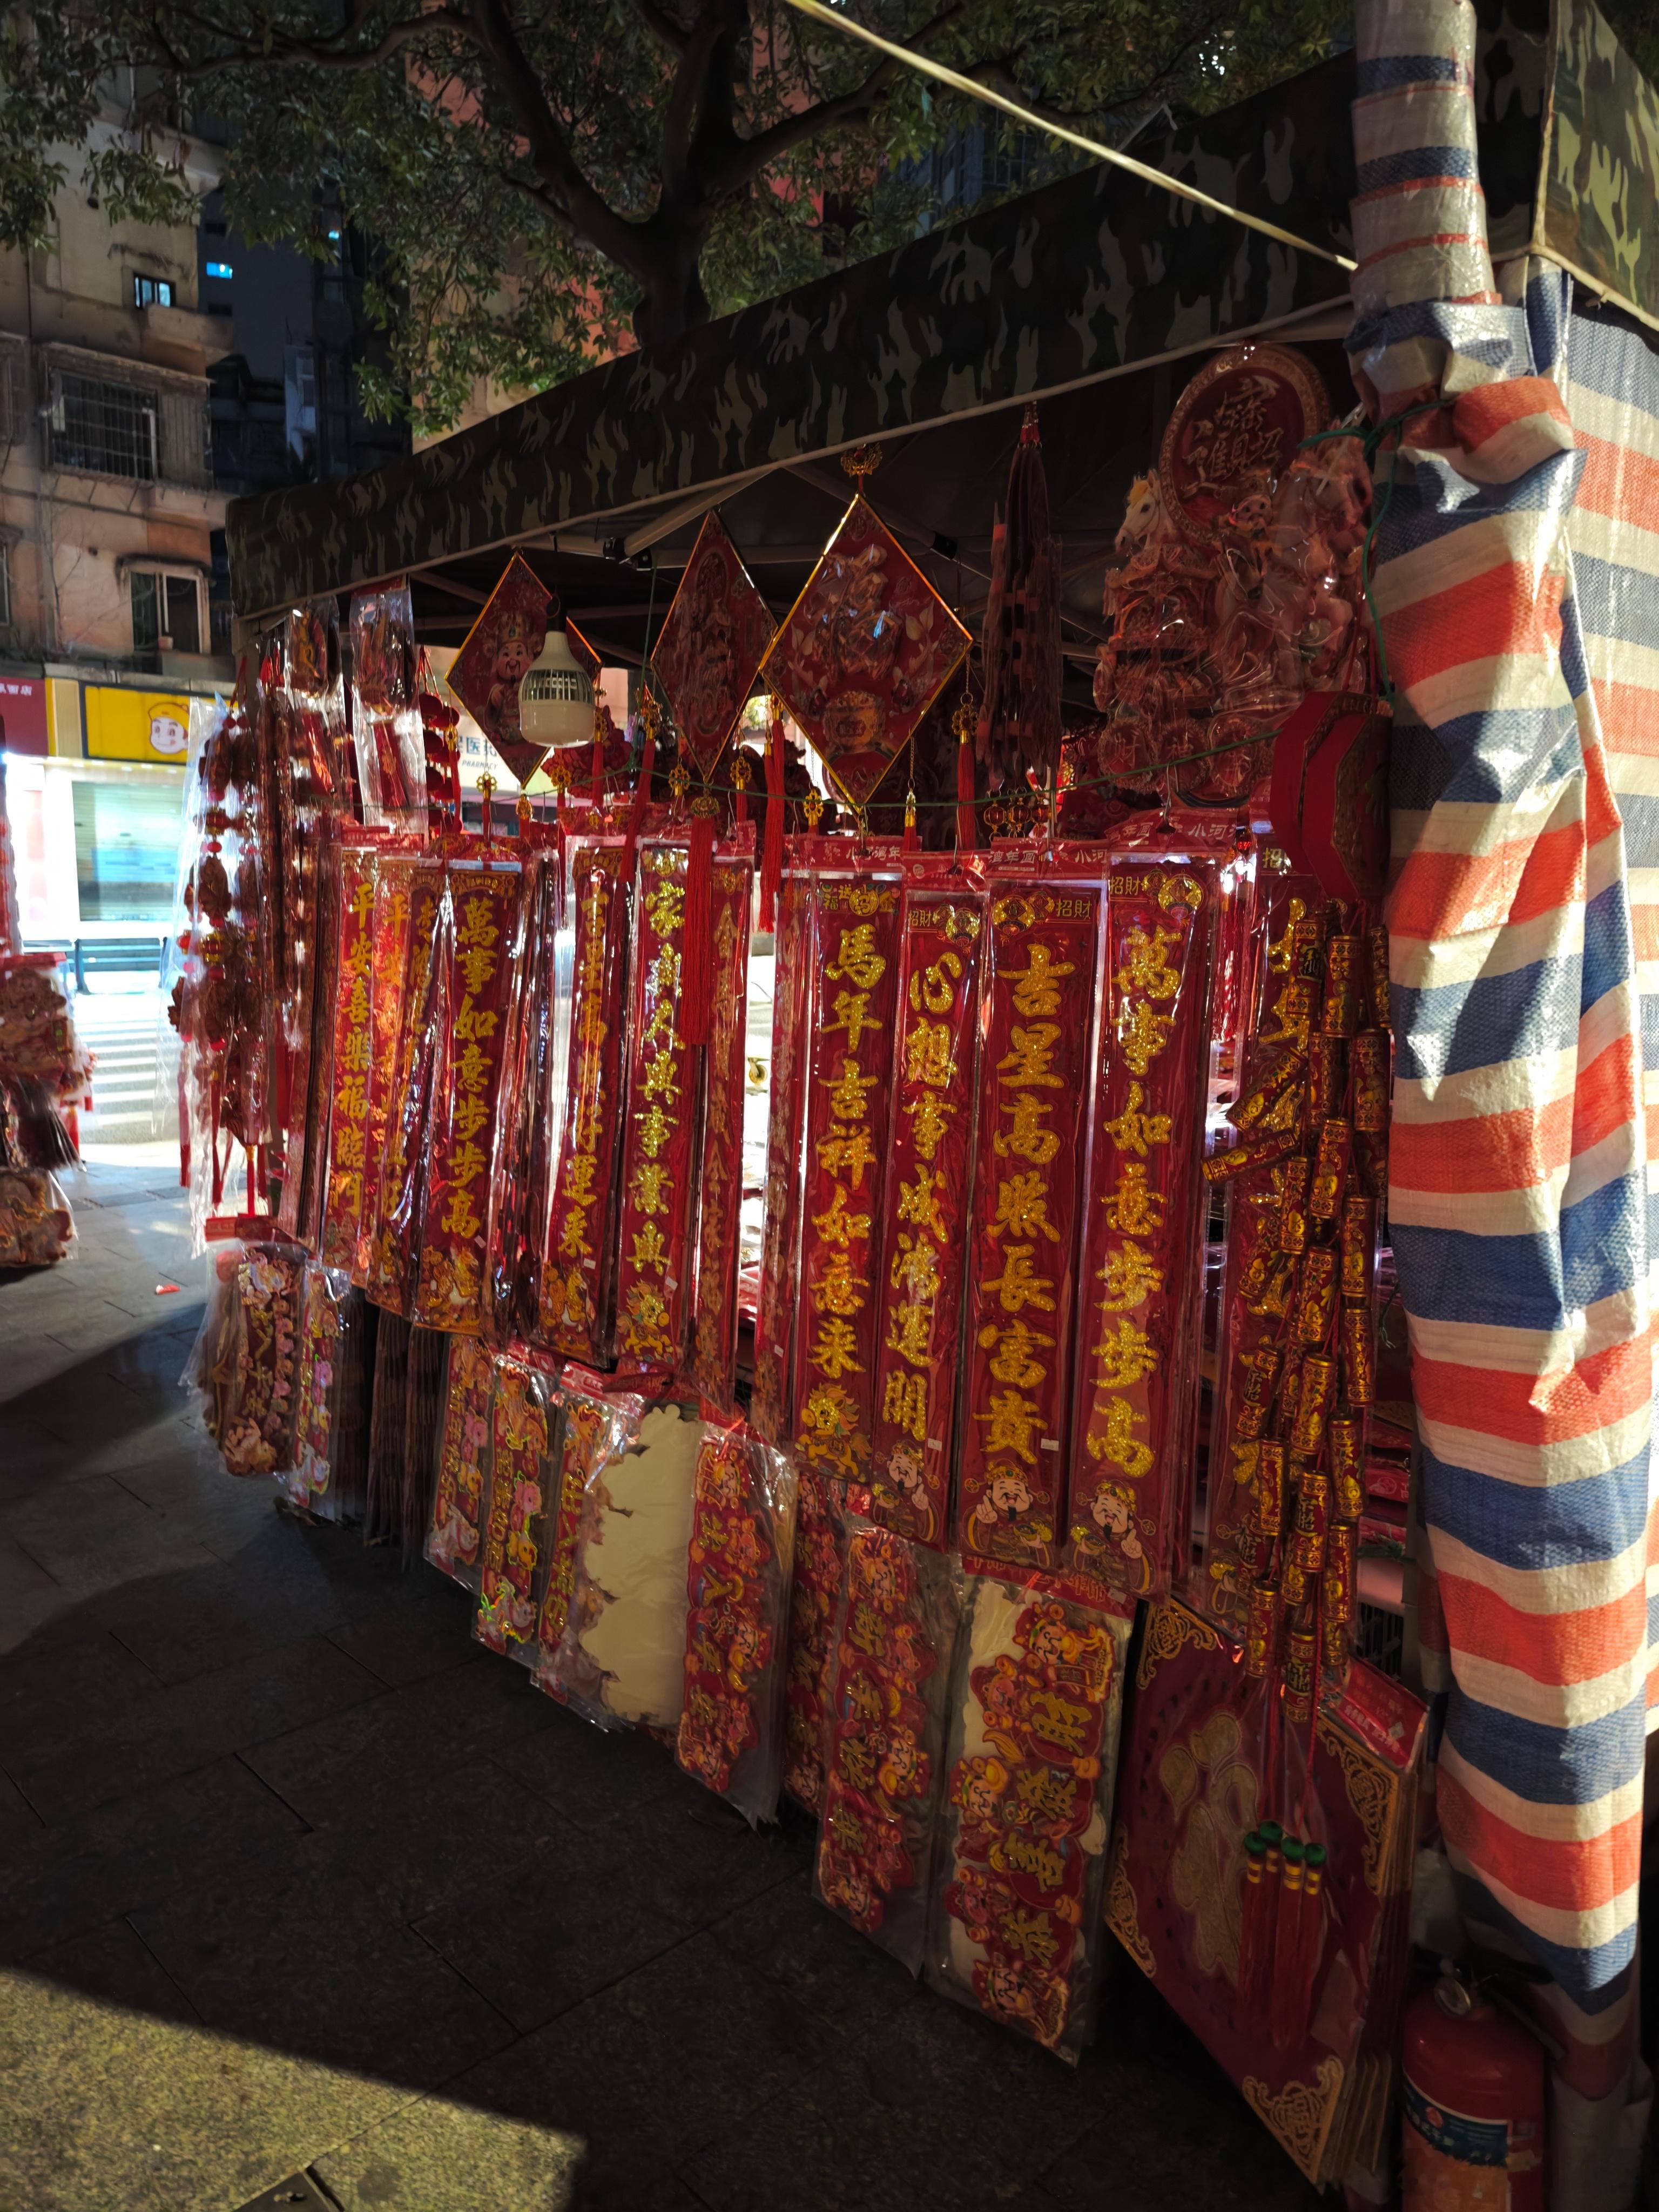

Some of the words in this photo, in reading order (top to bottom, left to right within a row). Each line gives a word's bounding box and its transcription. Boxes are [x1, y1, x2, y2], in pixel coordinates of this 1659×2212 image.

[462, 760, 498, 770] PHARMACY
[908, 908, 932, 927] 招財
[1055, 899, 1092, 920] 招財
[441, 896, 500, 1239] 萬事如意步步高
[973, 943, 1075, 1464] 吉星高照長富貴
[1086, 926, 1182, 1477] 萬事如意步步高
